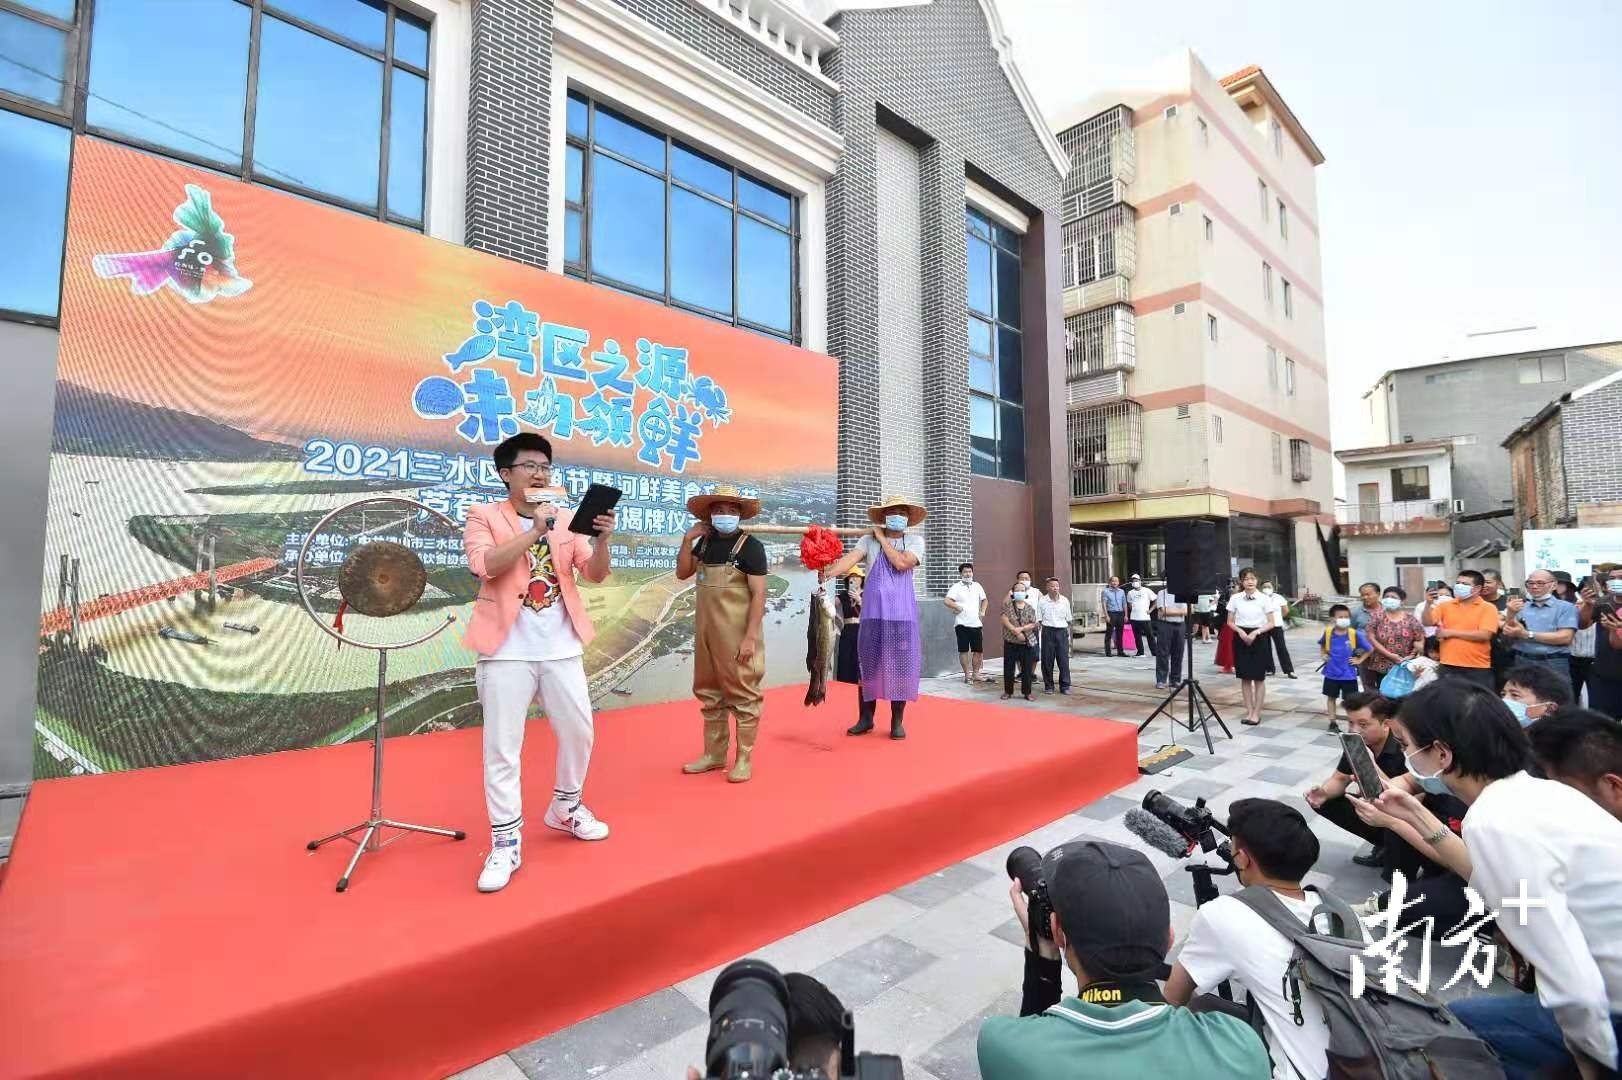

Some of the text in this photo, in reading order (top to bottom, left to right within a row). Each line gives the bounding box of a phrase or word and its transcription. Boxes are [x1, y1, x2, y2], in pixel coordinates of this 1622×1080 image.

[443, 300, 689, 401] 湾区之源
[1082, 988, 1122, 1002] Nikon
